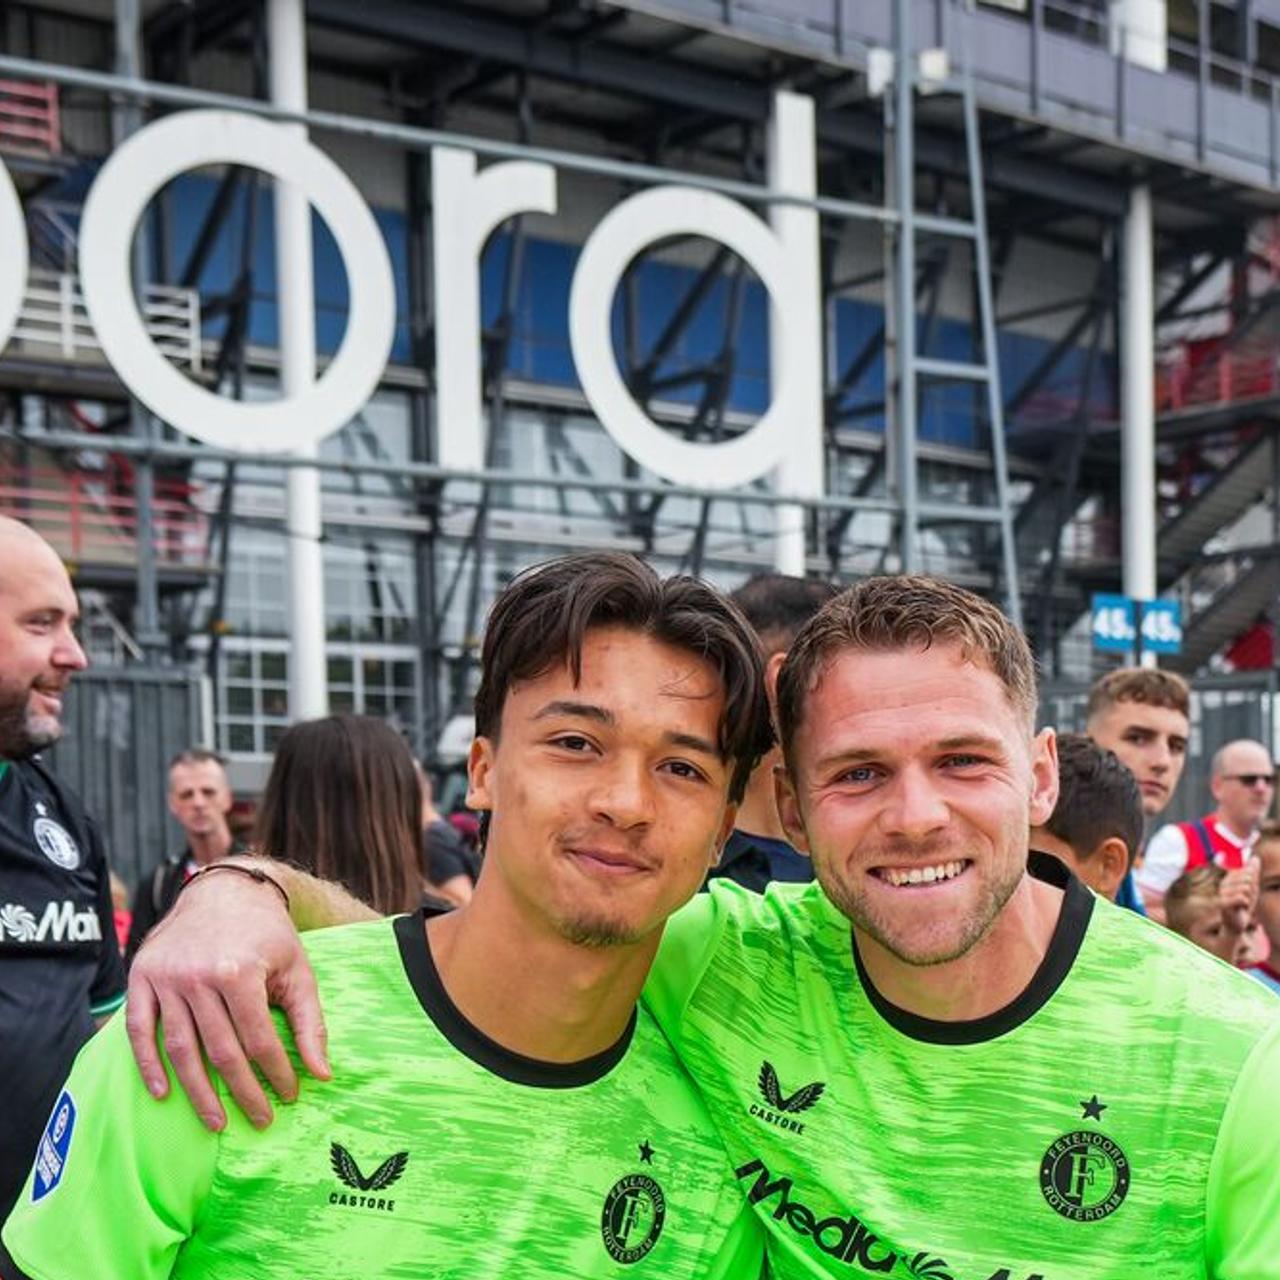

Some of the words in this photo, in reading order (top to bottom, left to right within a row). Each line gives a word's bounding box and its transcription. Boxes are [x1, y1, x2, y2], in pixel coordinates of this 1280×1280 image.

[749, 1104, 806, 1135] CASTORE
[1048, 1132, 1126, 1169] FEYENOORD
[328, 1192, 396, 1211] CASTORE
[735, 1159, 897, 1273] Media
[1043, 1185, 1122, 1221] ROTTERDAM
